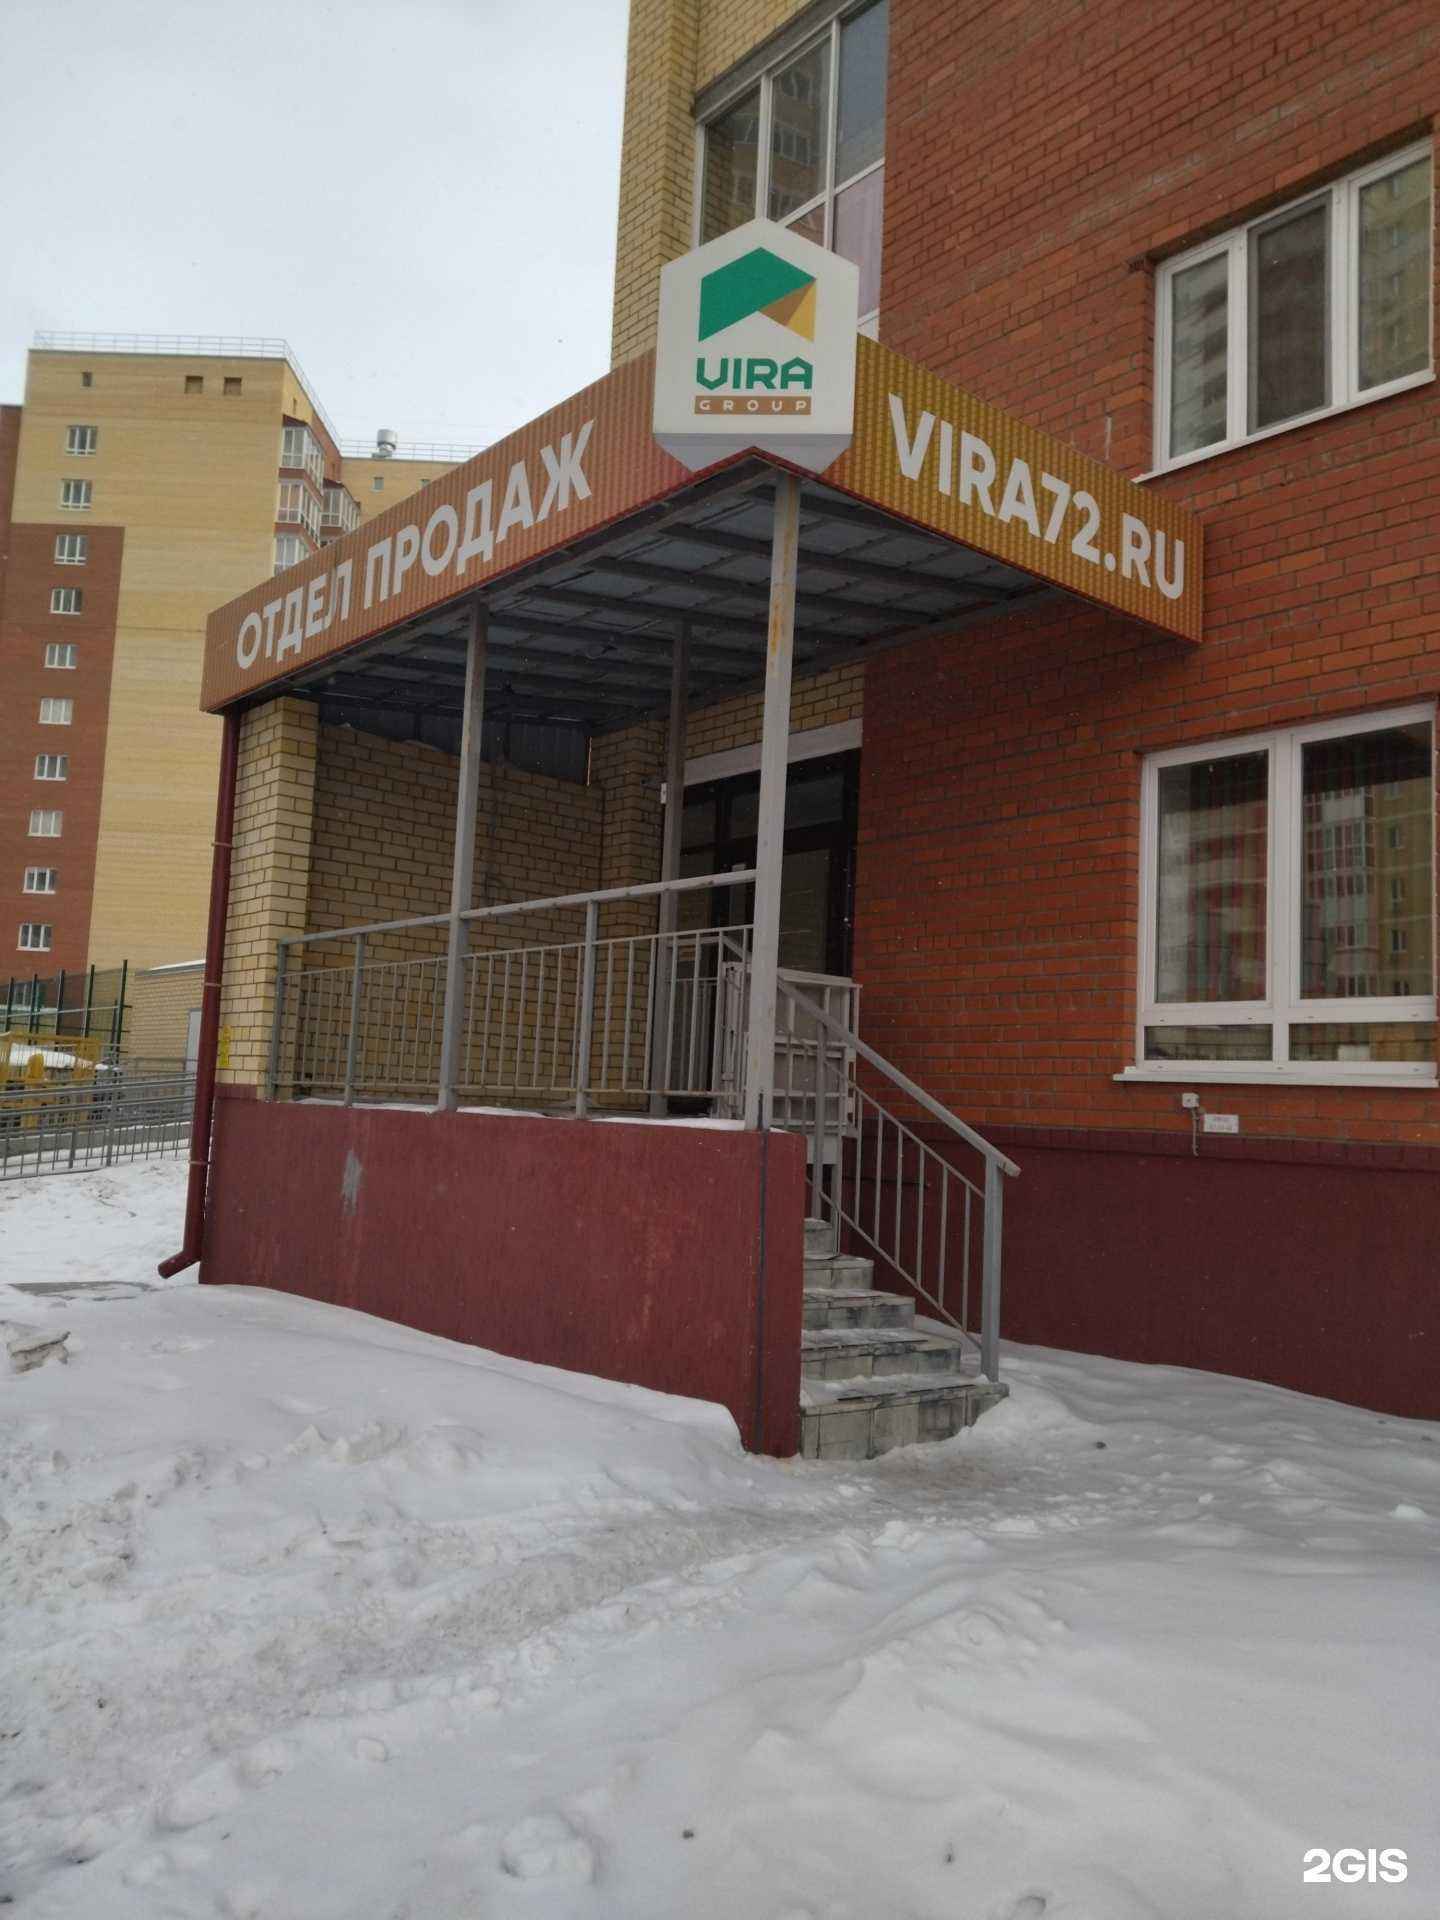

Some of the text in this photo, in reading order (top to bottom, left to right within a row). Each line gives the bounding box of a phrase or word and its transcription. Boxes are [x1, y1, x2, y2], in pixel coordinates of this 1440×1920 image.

[696, 357, 813, 390] VIRA
[699, 400, 808, 411] GROUP
[236, 419, 595, 670] ОТДЕЛ ПРОДАЖ
[888, 393, 1185, 600] VIRA72.RU
